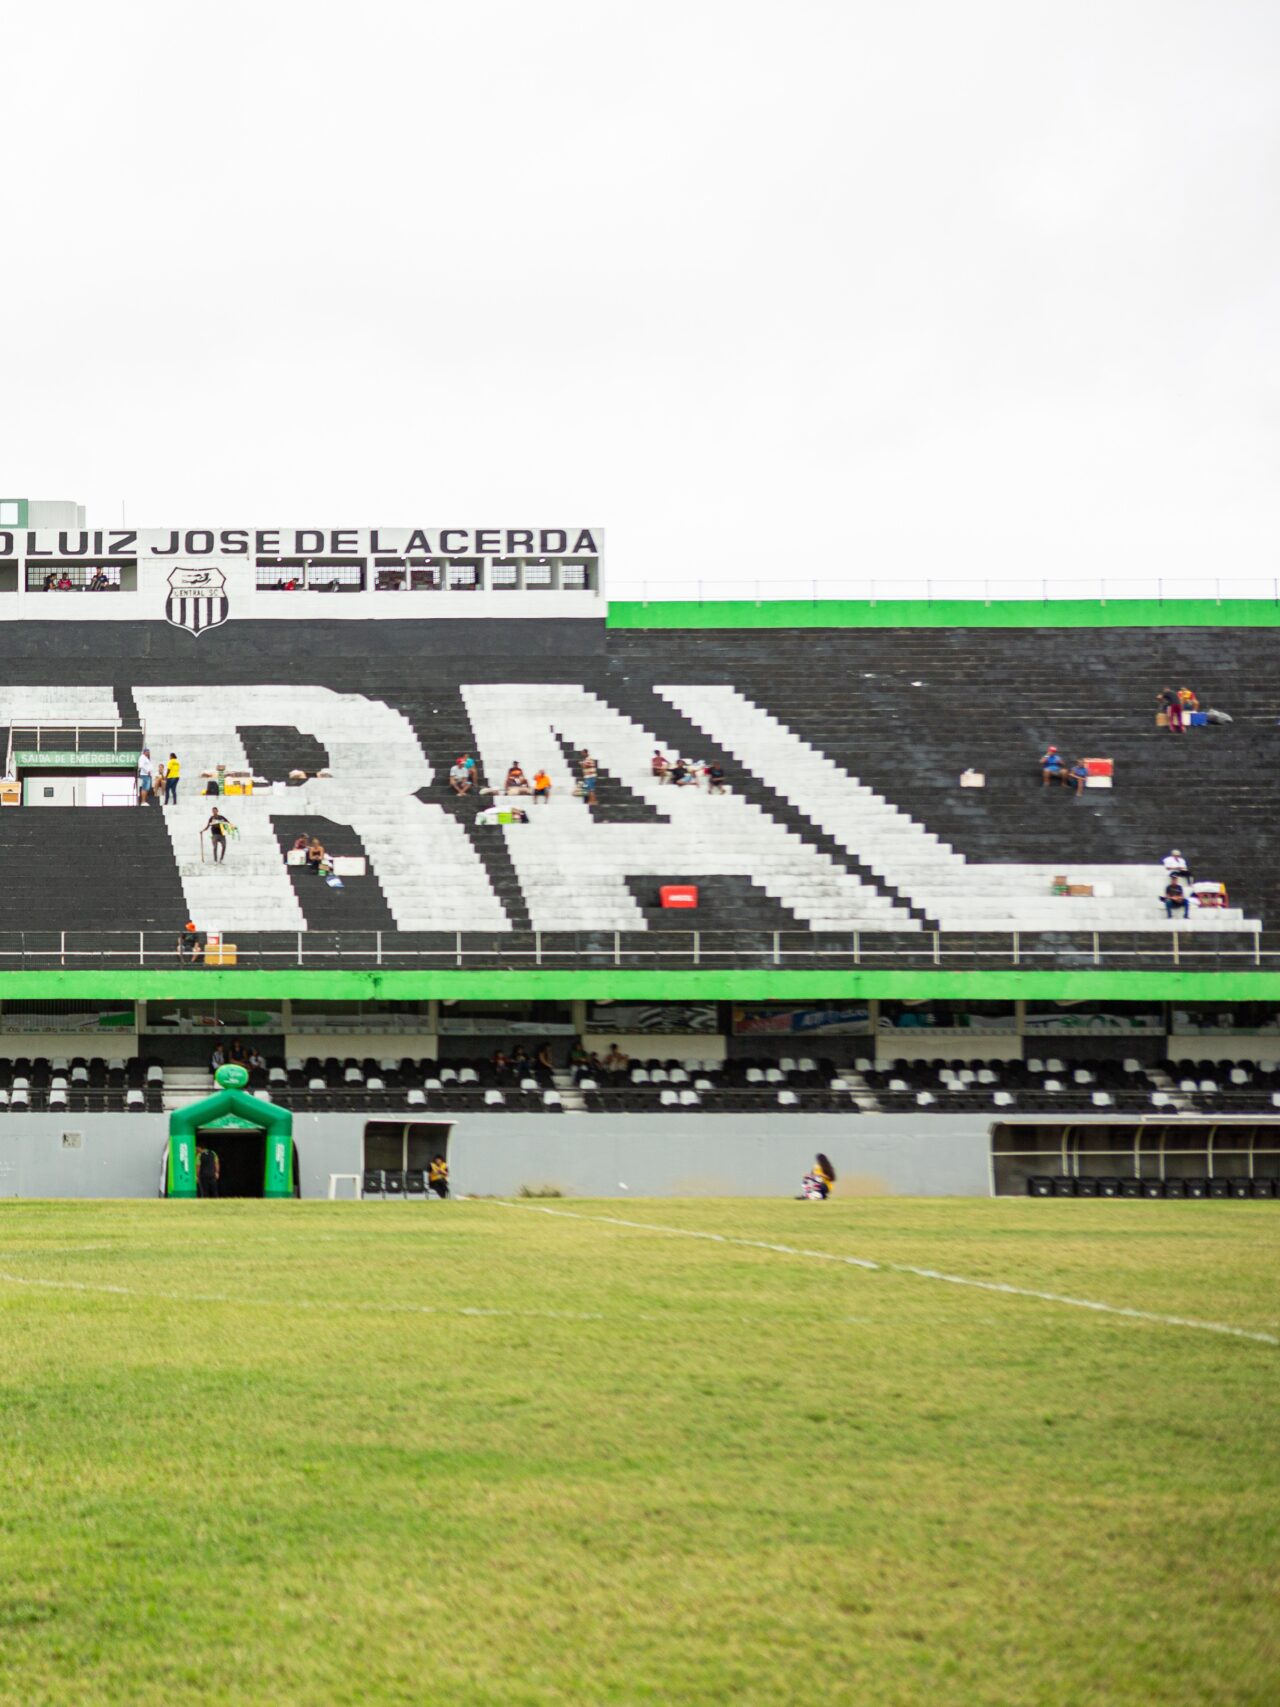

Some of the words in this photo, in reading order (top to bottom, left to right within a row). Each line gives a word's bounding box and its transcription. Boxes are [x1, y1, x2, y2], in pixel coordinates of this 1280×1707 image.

[26, 530, 137, 556] LUIZ
[150, 530, 280, 555] JOSE
[295, 530, 358, 554] DE
[370, 529, 598, 554] LACERDA
[174, 589, 205, 597] CENTRAL
[209, 589, 218, 597] SC
[55, 754, 65, 764] DE
